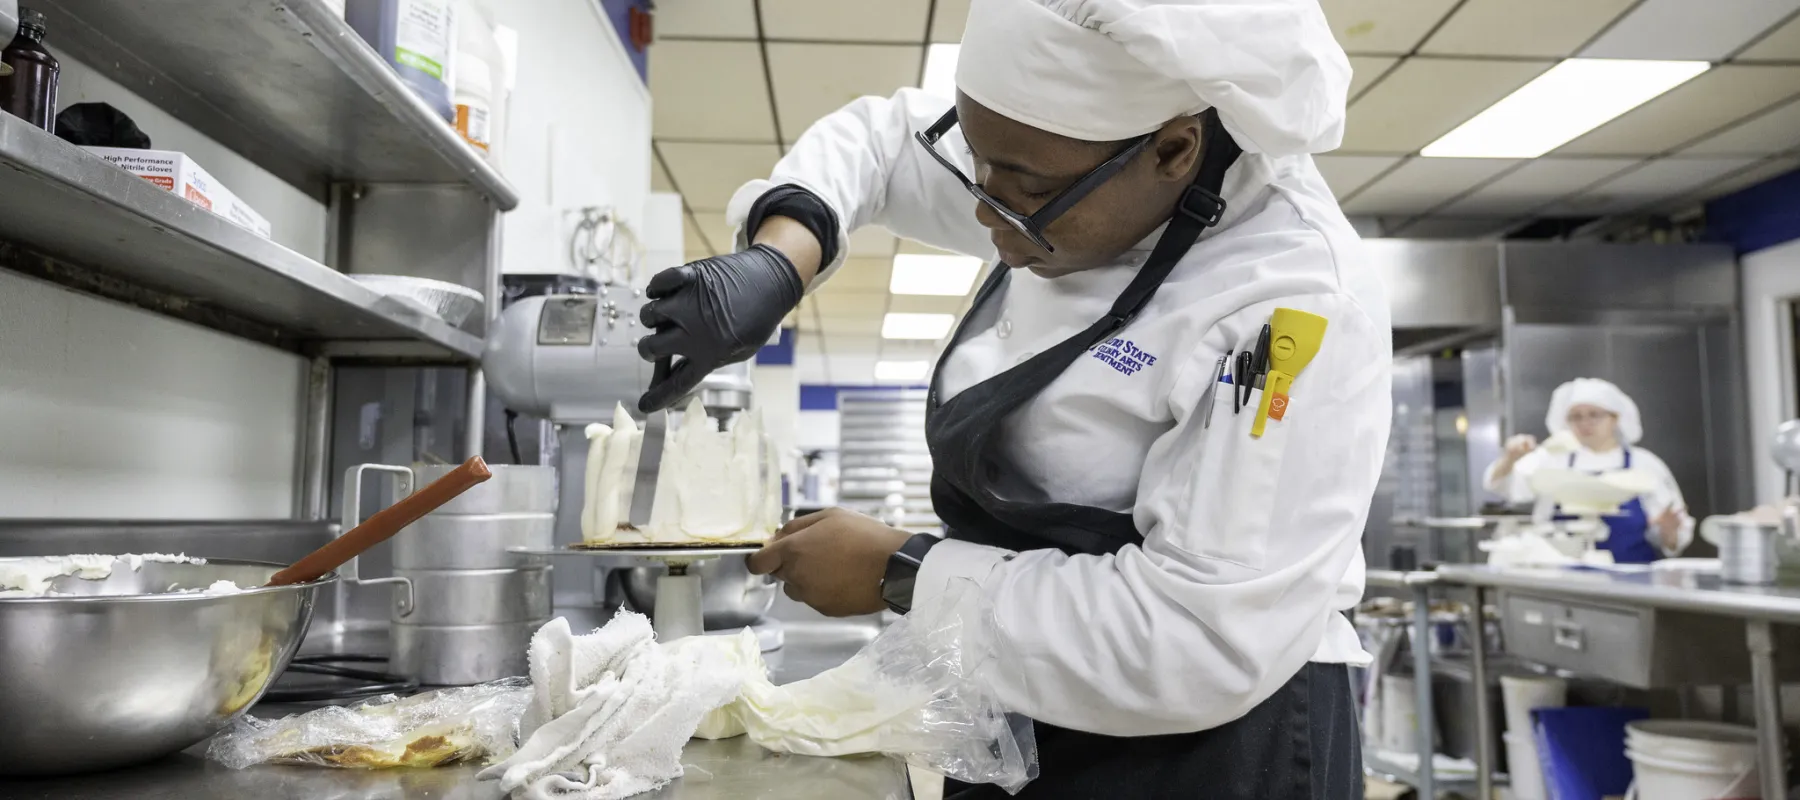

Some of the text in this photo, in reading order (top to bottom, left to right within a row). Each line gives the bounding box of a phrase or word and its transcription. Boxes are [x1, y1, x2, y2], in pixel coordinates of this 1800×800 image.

[103, 155, 173, 165] High Performance
[121, 163, 173, 173] Nitrile Gloves
[1122, 340, 1157, 366] STATE
[1119, 355, 1143, 372] ARTS
